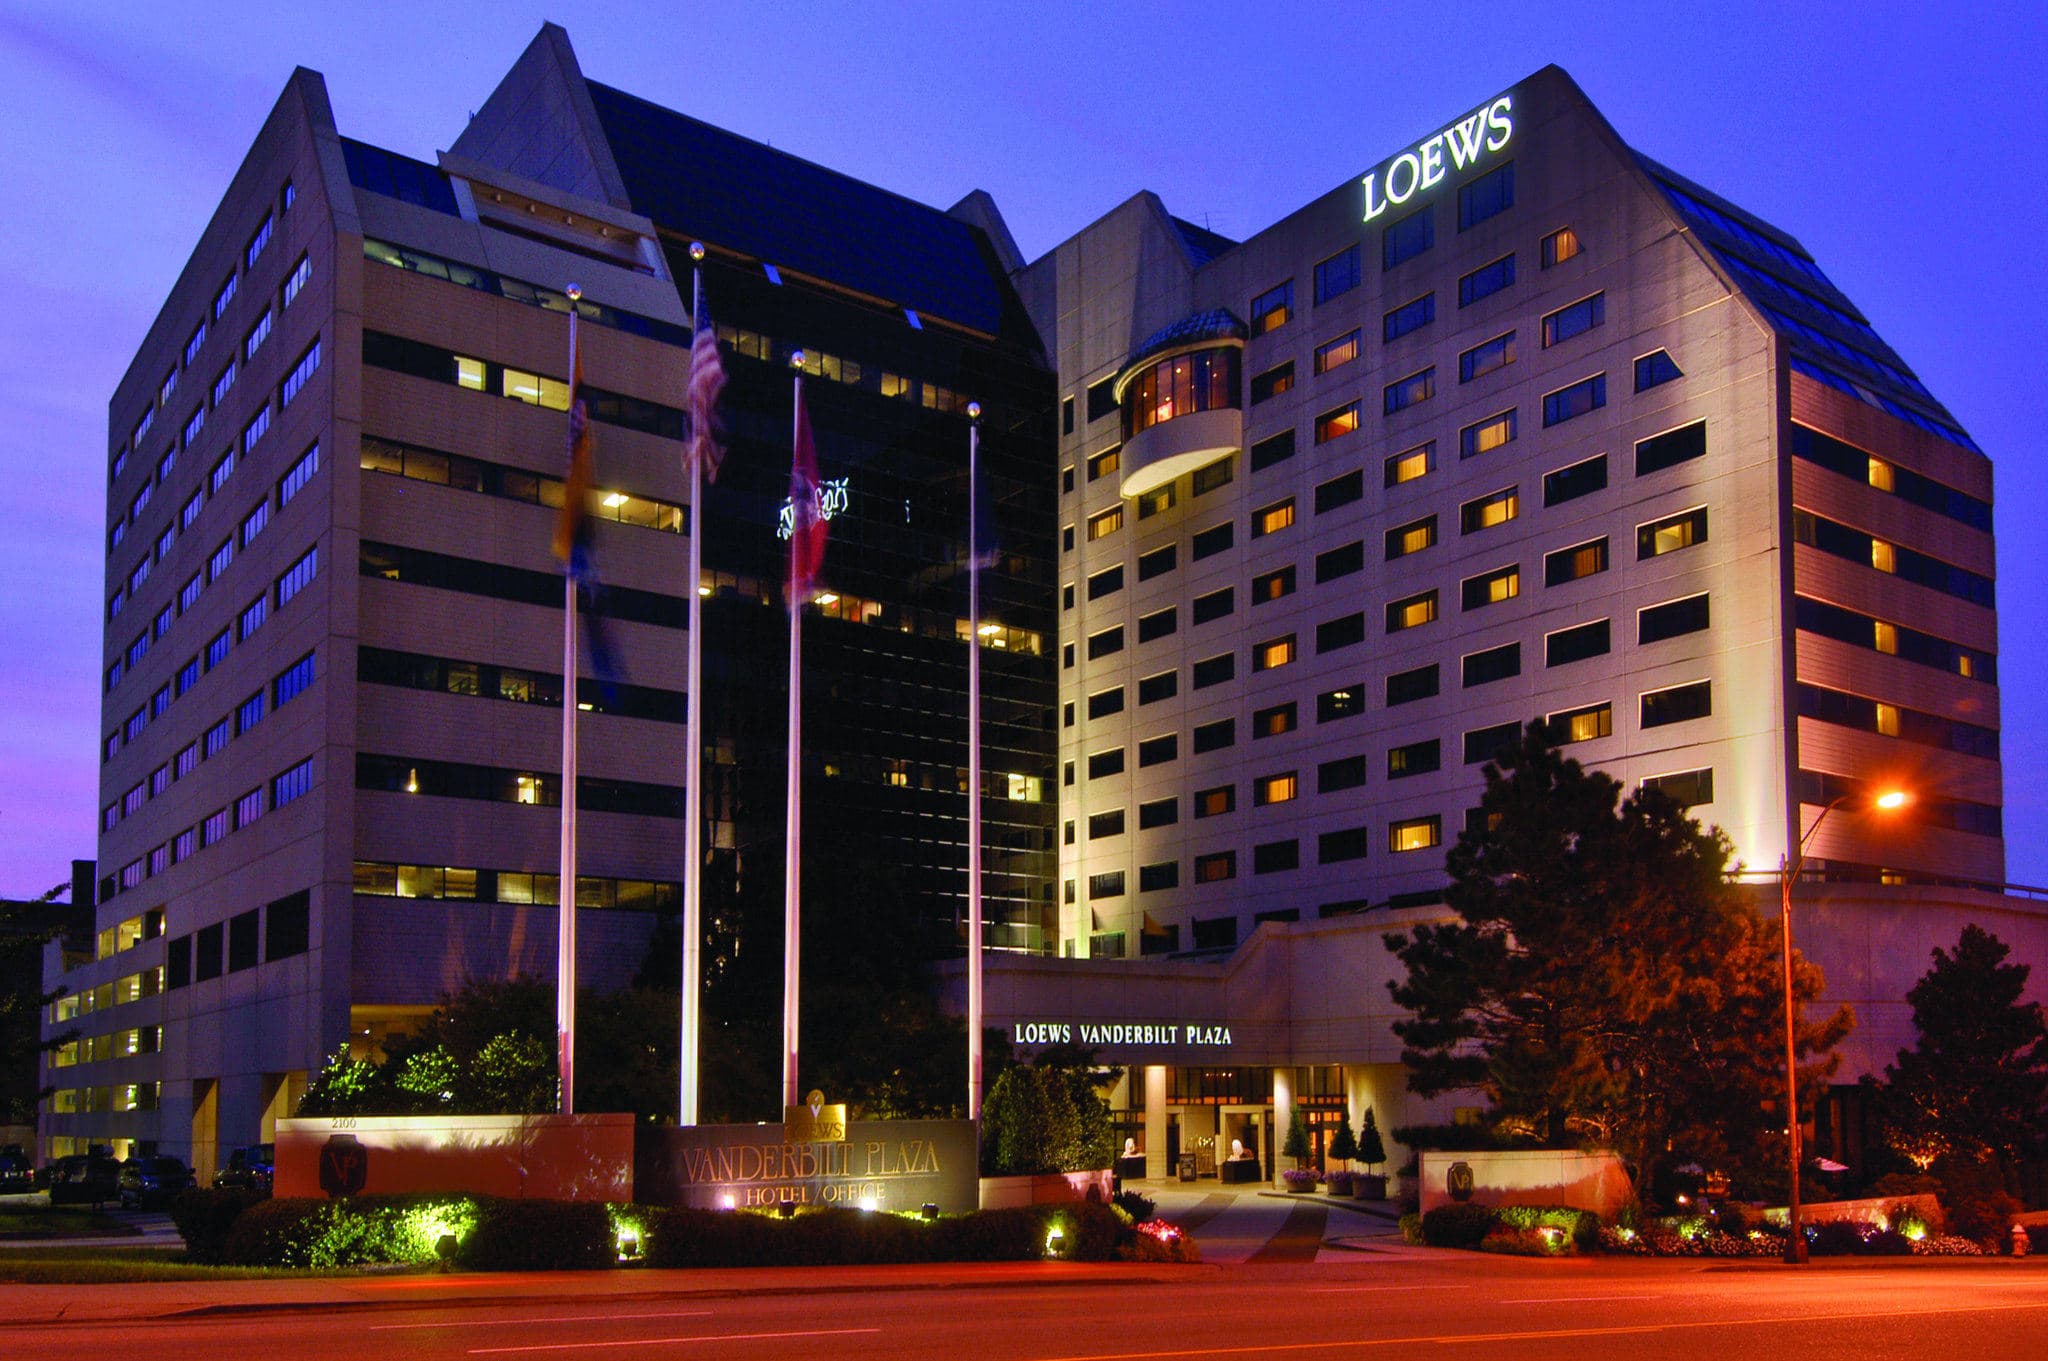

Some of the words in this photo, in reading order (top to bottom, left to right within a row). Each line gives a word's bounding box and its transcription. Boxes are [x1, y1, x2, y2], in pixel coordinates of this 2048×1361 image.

[1362, 96, 1512, 223] LOEWS
[1015, 1023, 1071, 1044] LOEWS
[1080, 1024, 1178, 1044] VANDERBILT
[1186, 1025, 1232, 1045] PLAZA
[331, 1116, 357, 1129] 2100
[787, 1121, 842, 1139] EWS
[682, 1141, 854, 1185] VANDERBILT
[864, 1140, 940, 1176] PLAZA
[746, 1185, 809, 1206] HOTEL
